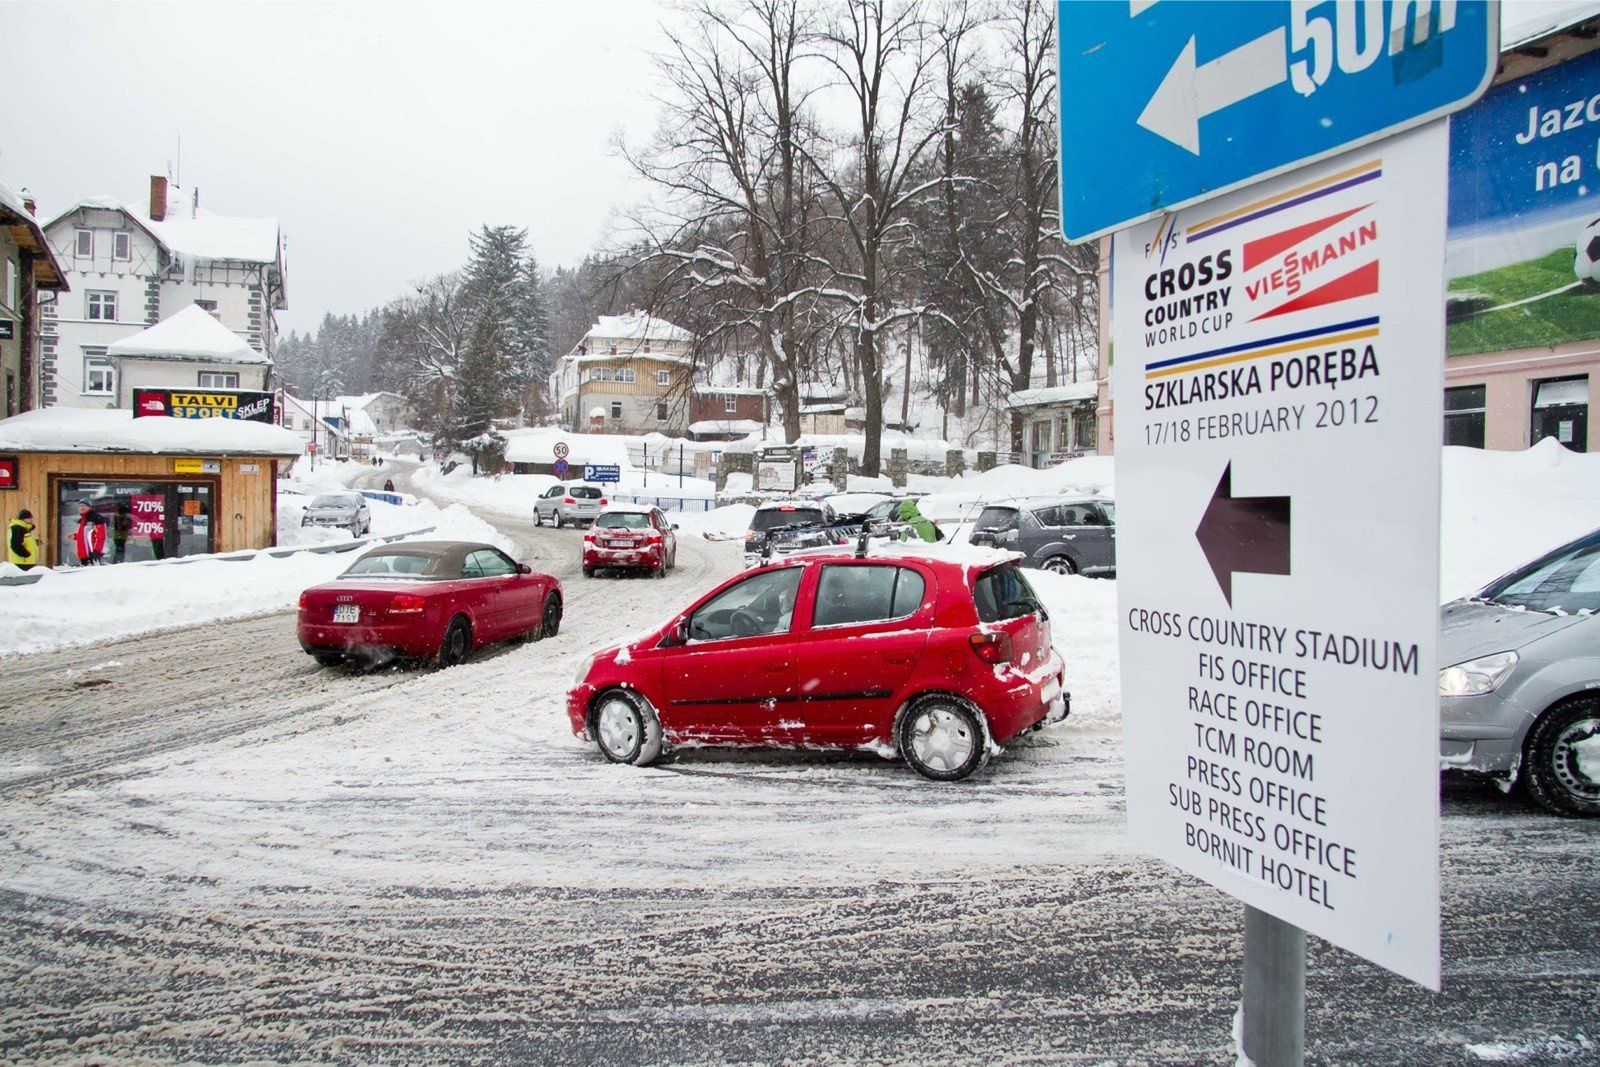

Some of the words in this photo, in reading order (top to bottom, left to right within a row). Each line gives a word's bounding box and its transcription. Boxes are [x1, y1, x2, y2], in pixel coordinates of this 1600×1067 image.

[1536, 155, 1580, 191] na
[1144, 249, 1233, 301] CROSS
[1244, 220, 1378, 302] VIESSMANN
[1144, 286, 1232, 327] COUNTRY
[1145, 321, 1198, 347] WORLD
[1202, 312, 1233, 335] CUP
[175, 395, 233, 406] TALVI
[1145, 366, 1262, 410] SZKLARSKA
[1271, 344, 1380, 390] PORĘBA
[172, 407, 236, 418] SPORT
[238, 398, 270, 415] SKLEP
[1145, 419, 1191, 445] 17/18
[1198, 404, 1306, 440] FEBRUARY
[1315, 395, 1379, 428] 2012
[556, 446, 567, 454] 50
[133, 501, 164, 512] -70%
[133, 522, 164, 533] -70%
[1128, 608, 1182, 637] CROSS
[1188, 616, 1287, 654] COUNTRY
[1295, 629, 1419, 676] STADIUM
[1199, 653, 1224, 681] FIS
[1232, 660, 1307, 699] OFFICE
[1188, 686, 1237, 722] RACE
[1245, 700, 1322, 743] OFFICE
[1195, 723, 1236, 758] TCM
[1244, 736, 1314, 781] ROOM
[1187, 755, 1241, 796] PRESS
[1249, 776, 1327, 827] OFFICE
[1169, 783, 1202, 816] SUB
[1209, 797, 1266, 843] PRESS
[1274, 823, 1357, 879] OFFICE
[1185, 822, 1254, 873] BORNIT
[1261, 854, 1336, 911] HOTEL
